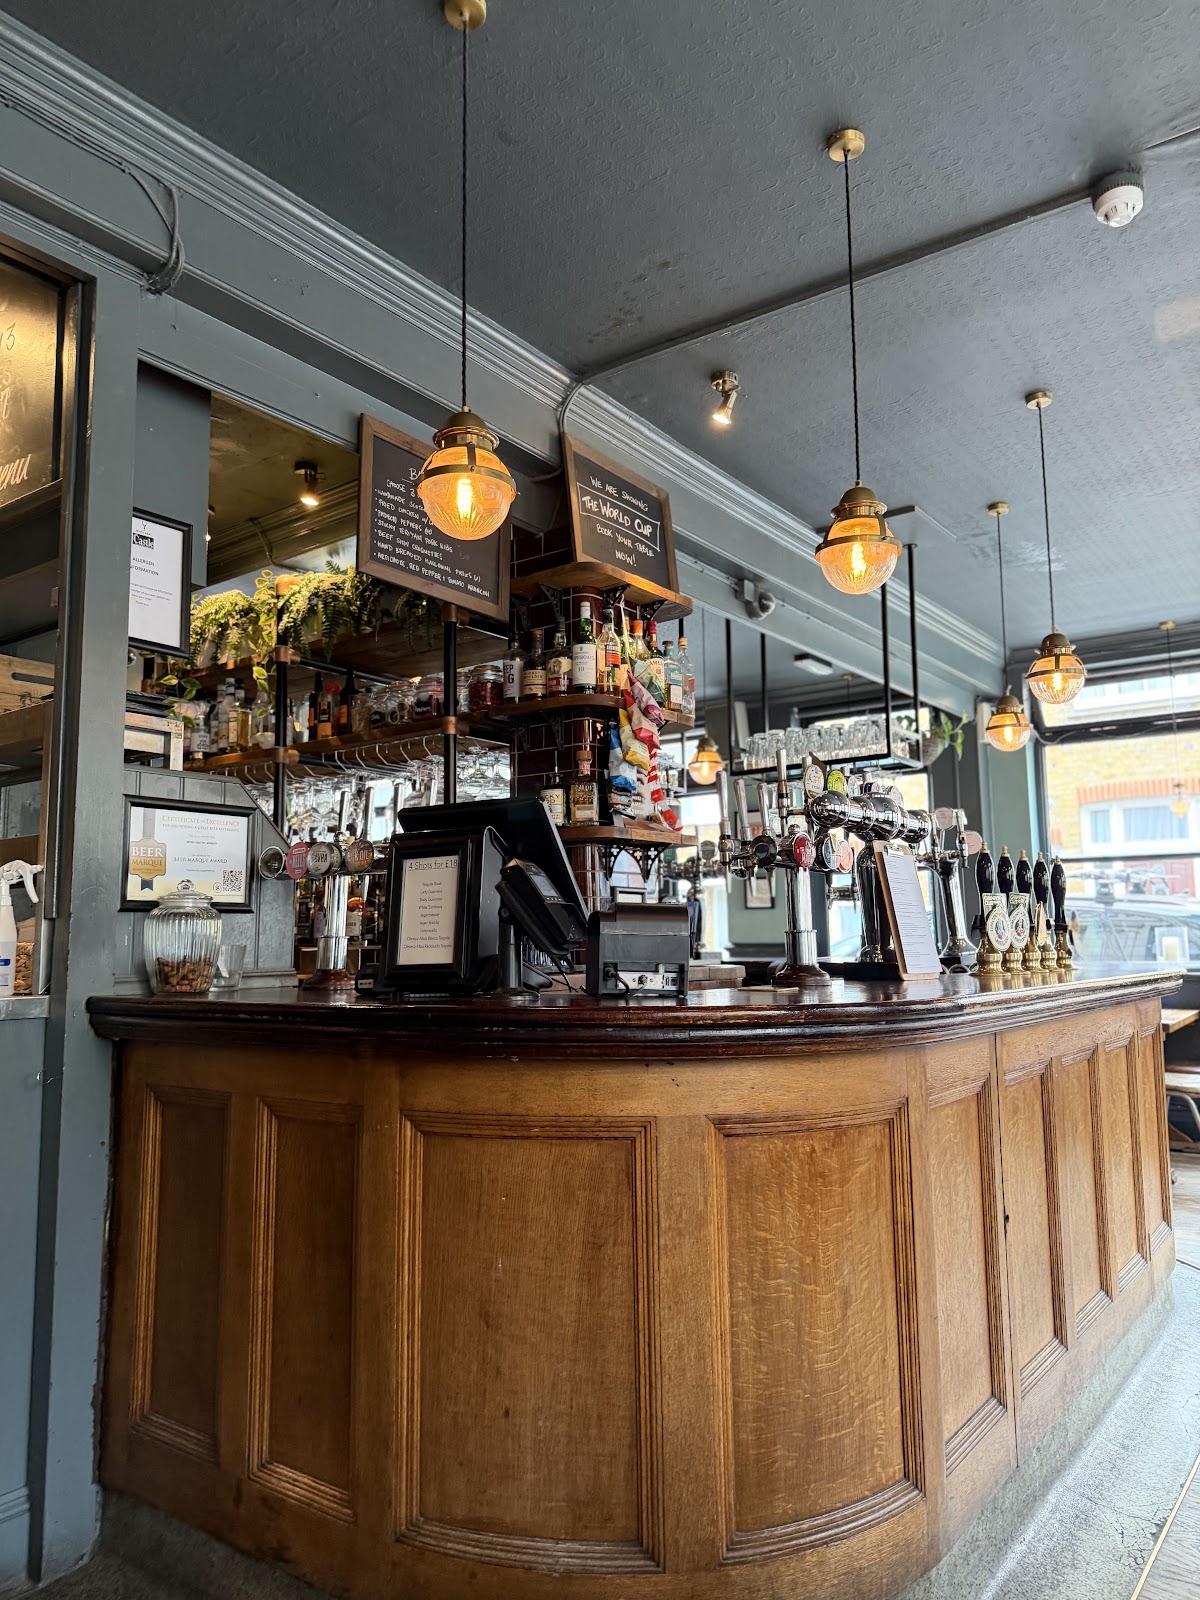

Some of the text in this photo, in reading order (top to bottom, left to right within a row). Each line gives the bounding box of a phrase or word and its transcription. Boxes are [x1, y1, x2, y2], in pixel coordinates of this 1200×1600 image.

[386, 479, 406, 493] CHOOSE
[590, 476, 649, 512] WE ARE SHOWING
[377, 489, 405, 504] HANDMADE
[378, 499, 395, 511] FRIED
[399, 507, 419, 520] CHICKEN
[582, 495, 653, 537] THE WORLD CUP
[400, 518, 422, 532] PEPPERS
[133, 533, 154, 548] Castle
[378, 519, 396, 531] STICKY
[425, 537, 438, 547] PORK
[440, 543, 453, 553] RIBS
[378, 530, 394, 541] BEEF
[396, 537, 410, 548] SHIN
[596, 523, 655, 557] BOOK YOUR TABLE
[377, 541, 393, 551] HAND
[396, 547, 422, 562] BREADED
[615, 549, 637, 567] NOW!
[409, 562, 420, 572] RED
[421, 567, 442, 581] PEPPER
[467, 583, 490, 598] ARANCINI
[132, 846, 164, 858] BEER
[132, 858, 164, 868] MARQUE
[414, 861, 433, 870] Shots
[434, 860, 444, 869] for
[445, 859, 458, 868] £18
